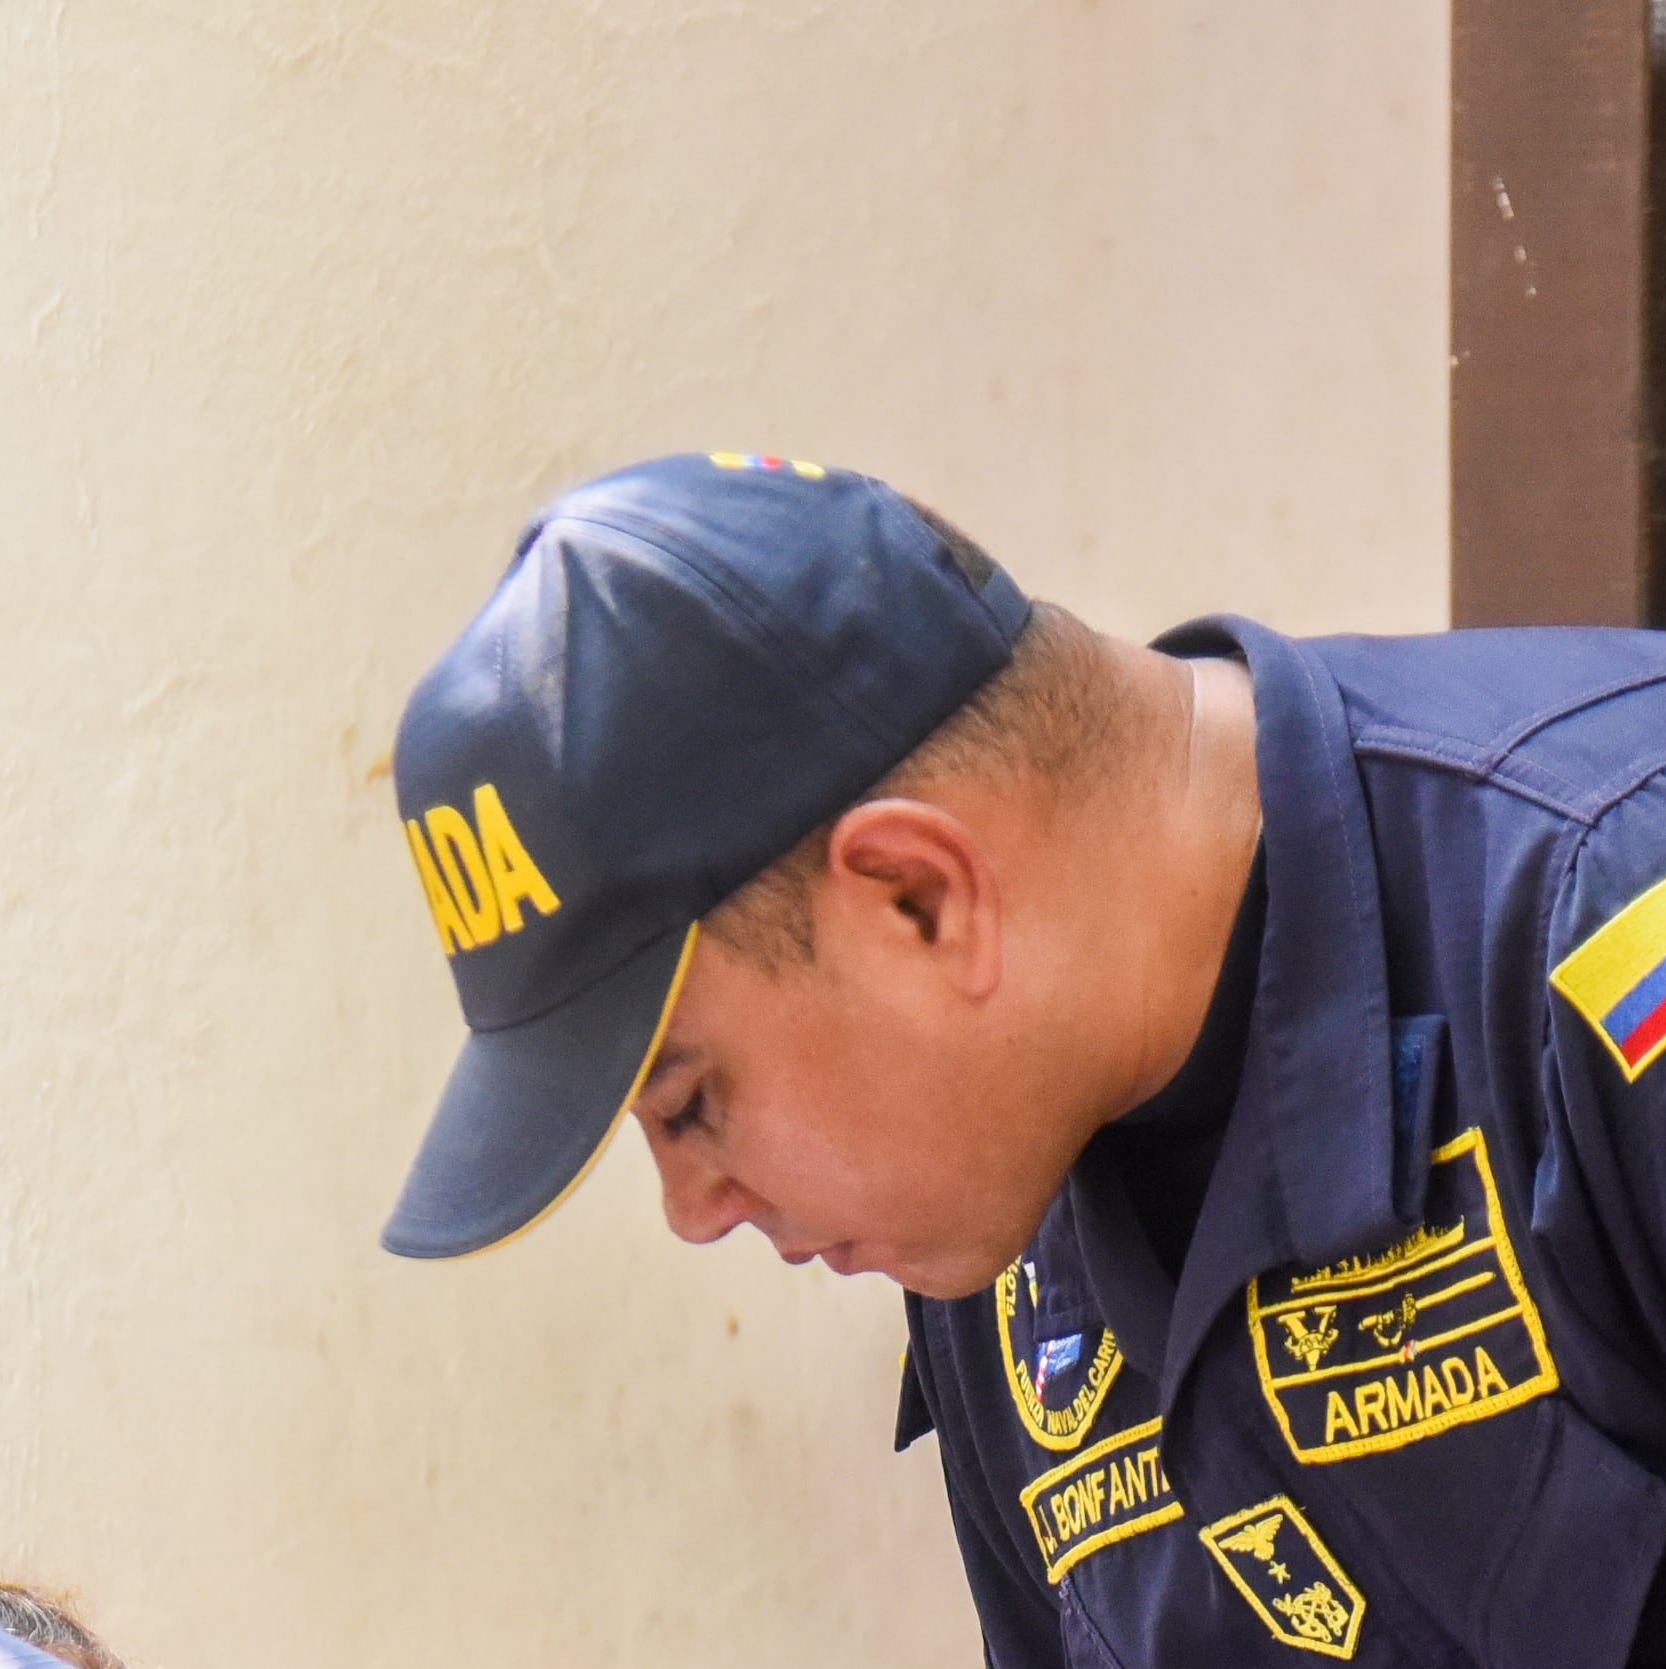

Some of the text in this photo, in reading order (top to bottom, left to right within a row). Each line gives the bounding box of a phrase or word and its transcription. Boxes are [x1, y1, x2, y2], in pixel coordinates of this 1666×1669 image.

[402, 783, 562, 957] ADA
[1074, 1384, 1095, 1421] DEL
[1326, 1346, 1508, 1444] ARMADA
